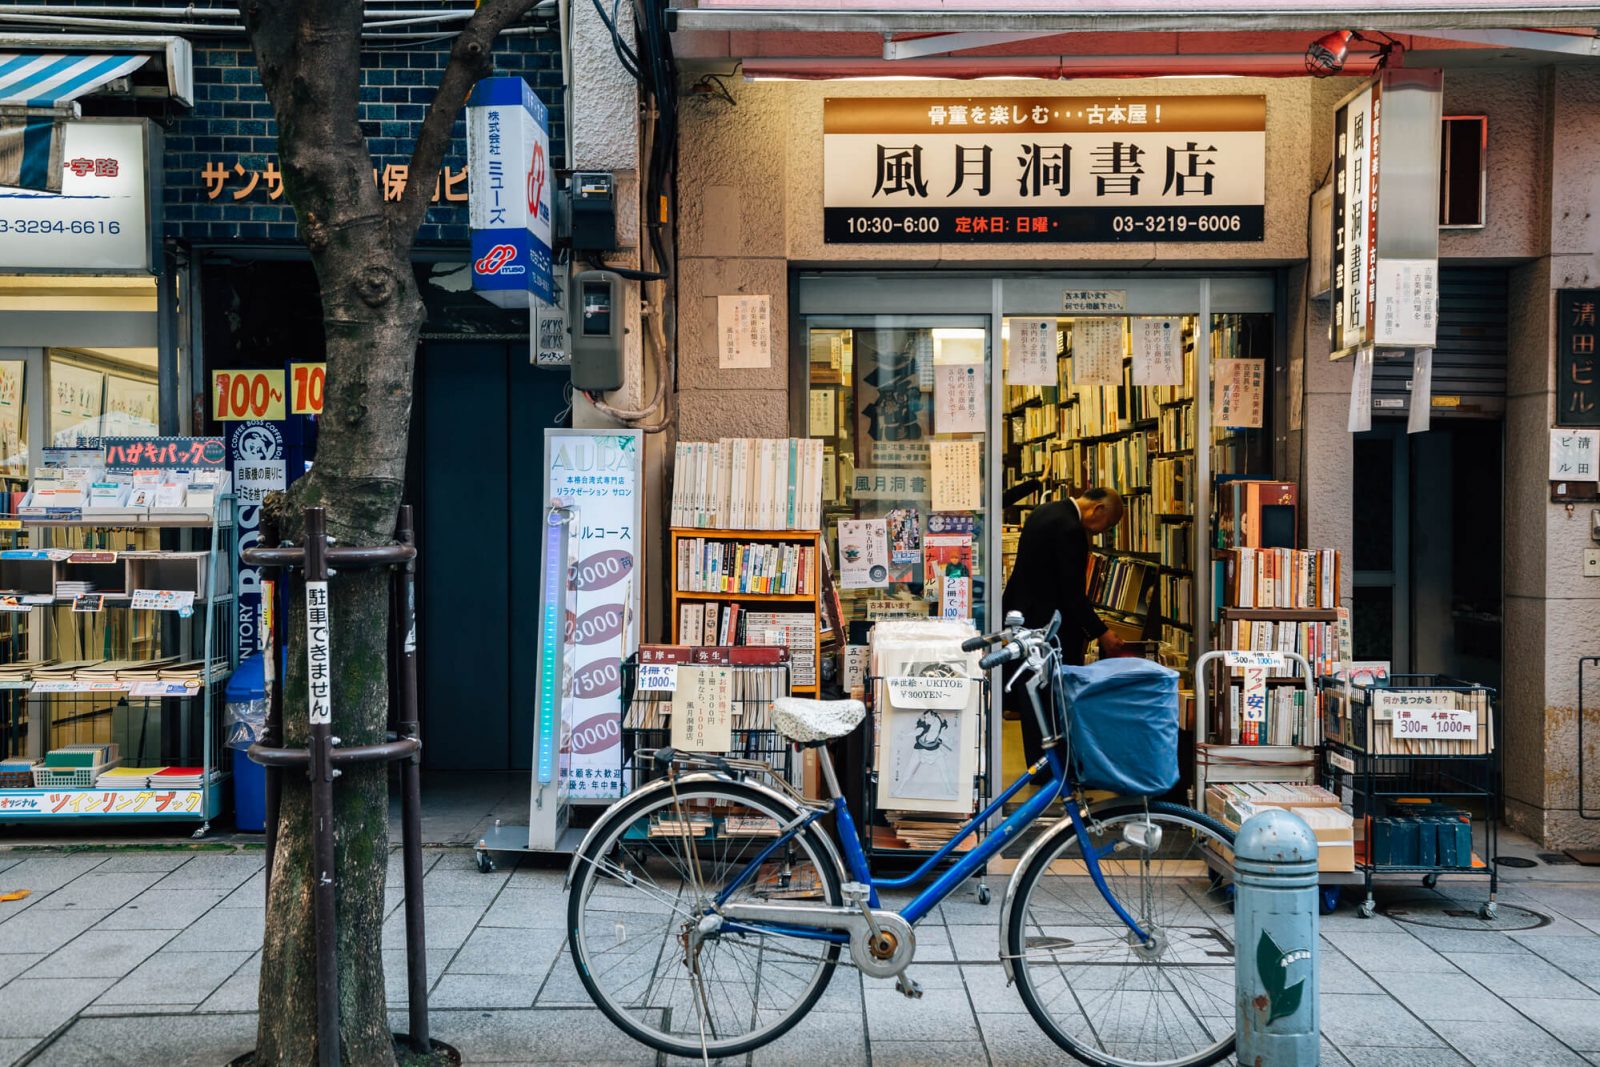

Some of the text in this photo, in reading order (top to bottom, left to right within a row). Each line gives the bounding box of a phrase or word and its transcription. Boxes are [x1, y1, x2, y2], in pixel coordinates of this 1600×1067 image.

[63, 158, 119, 178] 字路
[871, 141, 1218, 198] 風月洞書店
[1112, 215, 1241, 233] 03-3219-6006
[1350, 112, 1364, 330] 風月洞書店
[1572, 302, 1595, 413] 清田ビル
[246, 419, 264, 427] BOSS
[107, 442, 204, 464] ハガキパック
[238, 467, 282, 481] 自販機の周りに
[556, 487, 632, 497] リラクゼーション サロン
[308, 588, 329, 717] 駐車できません
[1400, 720, 1428, 733] 300円
[49, 791, 202, 813] ツインリングブック
